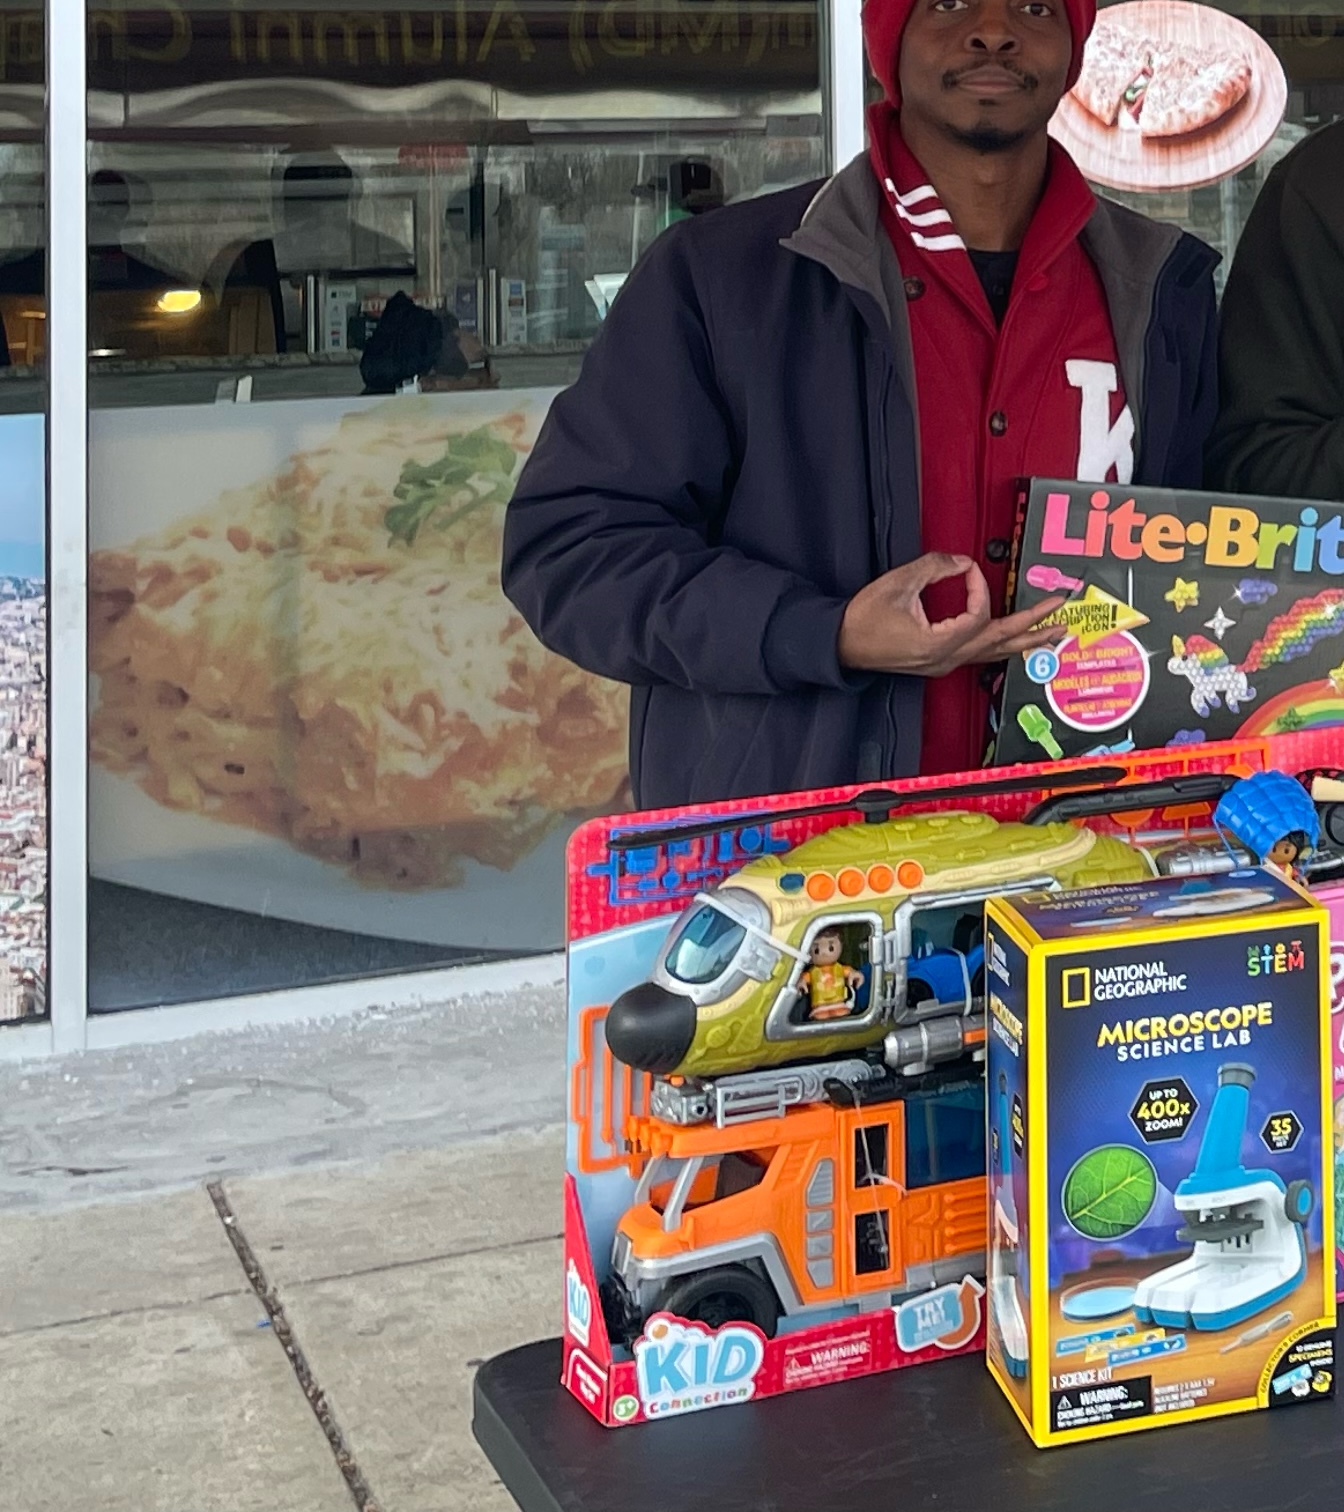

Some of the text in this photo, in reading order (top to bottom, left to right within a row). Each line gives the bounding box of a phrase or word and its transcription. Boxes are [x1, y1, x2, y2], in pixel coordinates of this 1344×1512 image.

[1034, 654, 1051, 678] 6
[1095, 961, 1168, 984] NATIONAL
[1247, 950, 1305, 977] STEM
[1094, 975, 1187, 1001] GEOGRAPHIC
[1097, 1001, 1273, 1048] MICROSCOPE
[1117, 1029, 1253, 1063] SCIENCE LAB
[1145, 1118, 1183, 1132] ZOOM!
[1270, 1117, 1292, 1136] 35
[644, 1333, 758, 1395] KID
[1059, 1370, 1097, 1388] SCIENCE
